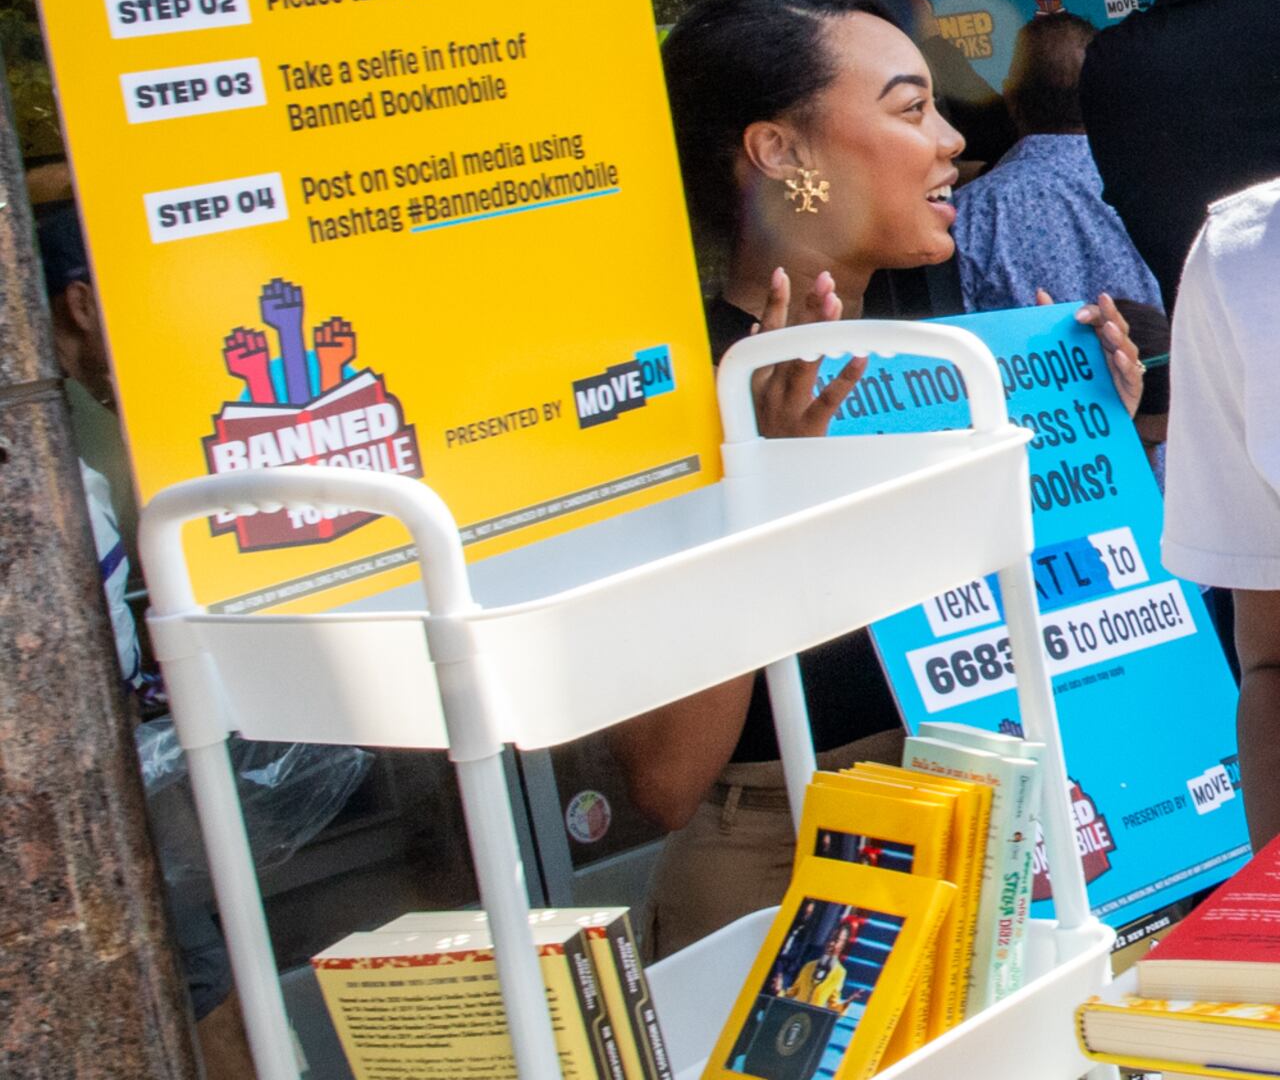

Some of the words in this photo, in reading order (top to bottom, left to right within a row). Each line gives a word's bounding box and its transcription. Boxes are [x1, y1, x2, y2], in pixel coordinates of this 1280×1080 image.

[135, 78, 209, 108] STEP
[216, 72, 252, 97] 03
[279, 61, 333, 92] Take
[338, 60, 353, 84] a
[357, 49, 420, 82] selfie
[422, 46, 445, 72] in
[447, 38, 503, 68] front
[506, 32, 527, 60] of
[287, 92, 376, 131] Banned
[381, 74, 507, 117] Bookmobile
[301, 170, 355, 204] Post
[360, 167, 389, 194] on
[393, 151, 458, 188] social
[462, 143, 525, 176] media
[529, 133, 585, 163] using
[158, 195, 229, 228] STEP
[237, 187, 276, 214] 04
[308, 204, 404, 244] hashtag
[407, 161, 619, 224] #BannedBookmobile
[904, 365, 972, 408] mor
[1000, 340, 1094, 400] people
[212, 402, 399, 474] BANNED
[446, 407, 539, 448] PRESENTED
[543, 400, 562, 422] BY
[1073, 399, 1111, 439] to
[1030, 454, 1118, 514] ooks?
[1108, 543, 1137, 576] to
[935, 580, 990, 622] Text
[1069, 620, 1098, 653] to
[1099, 592, 1184, 646] donate!
[1122, 797, 1175, 830] PRESENTED
[1174, 795, 1188, 811] BY
